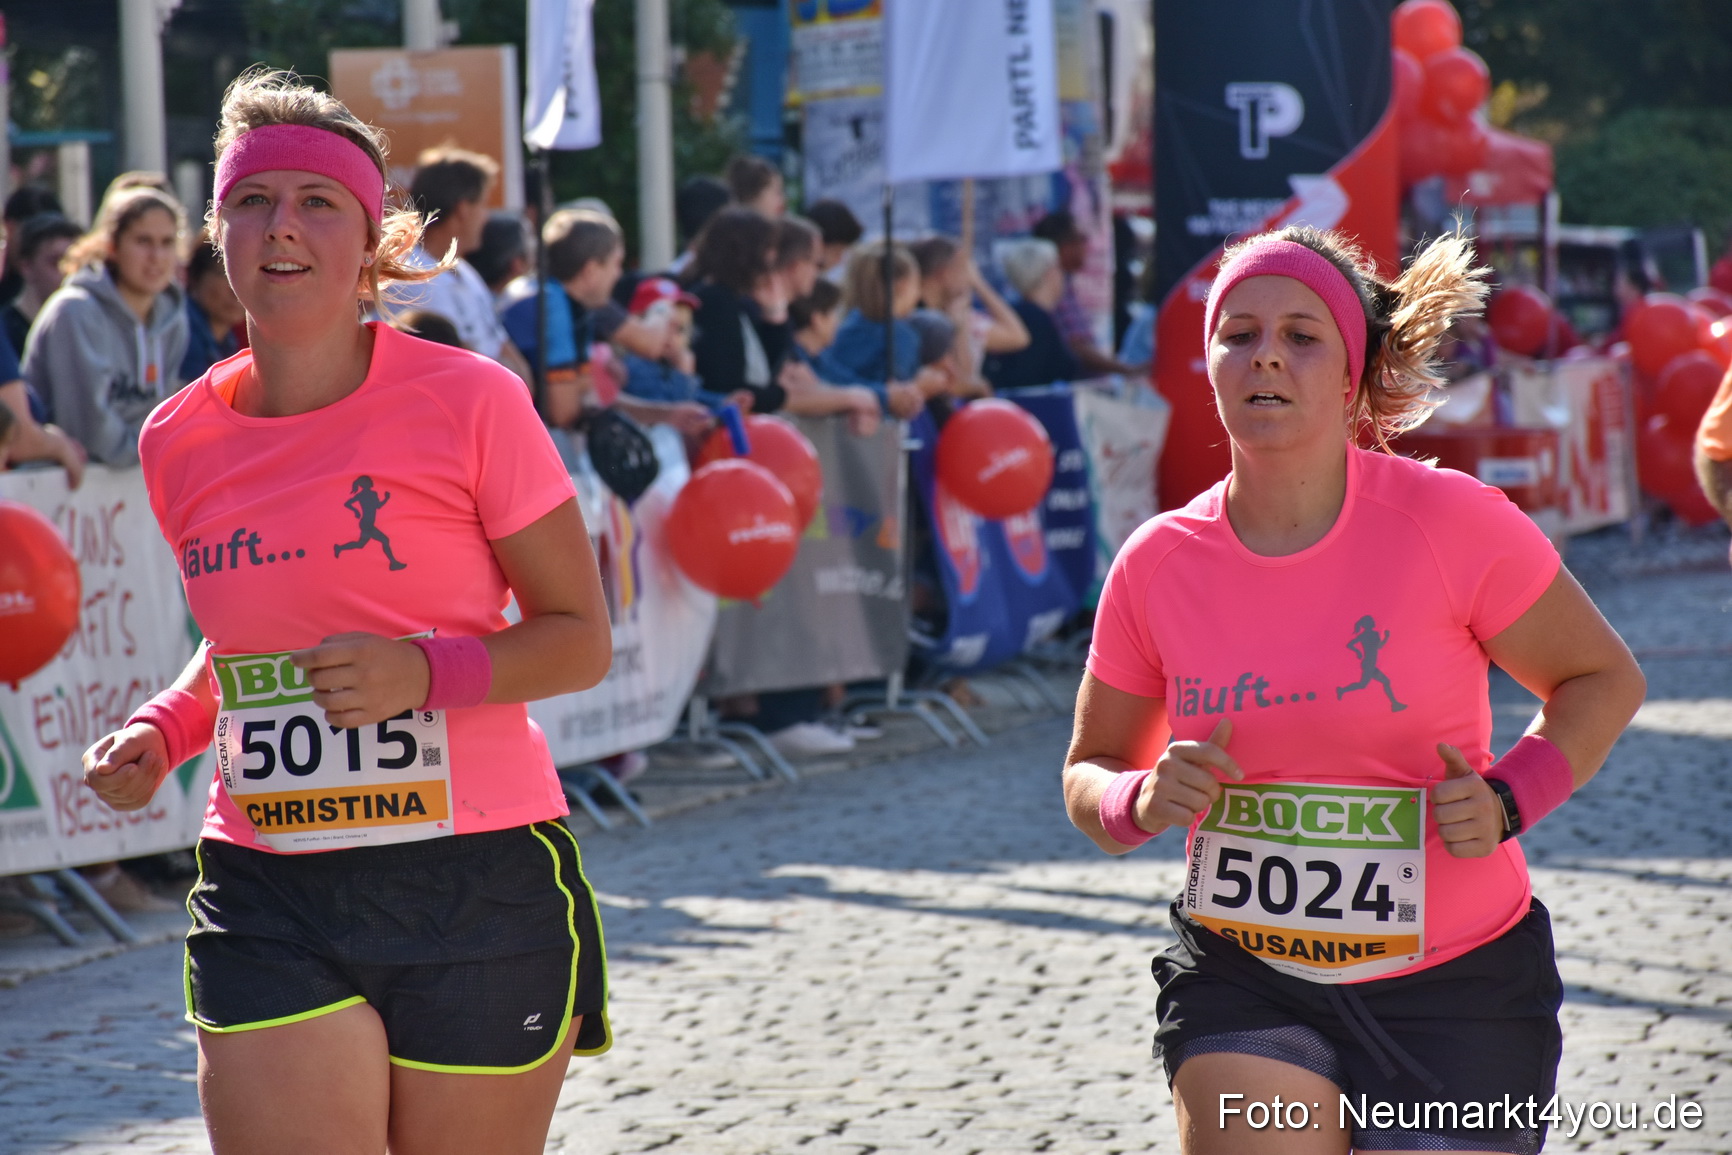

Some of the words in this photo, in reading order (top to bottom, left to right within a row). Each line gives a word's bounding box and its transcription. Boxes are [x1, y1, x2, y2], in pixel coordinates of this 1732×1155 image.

[183, 527, 306, 580] läuft...
[423, 711, 434, 723] S
[1174, 671, 1317, 718] läuft...
[241, 709, 418, 780] 5015
[247, 791, 427, 827] CHRISTINA
[1219, 790, 1400, 839] BOCK
[1211, 847, 1395, 922] 5024
[1402, 867, 1413, 879] S
[1220, 927, 1387, 963] SUSANNE
